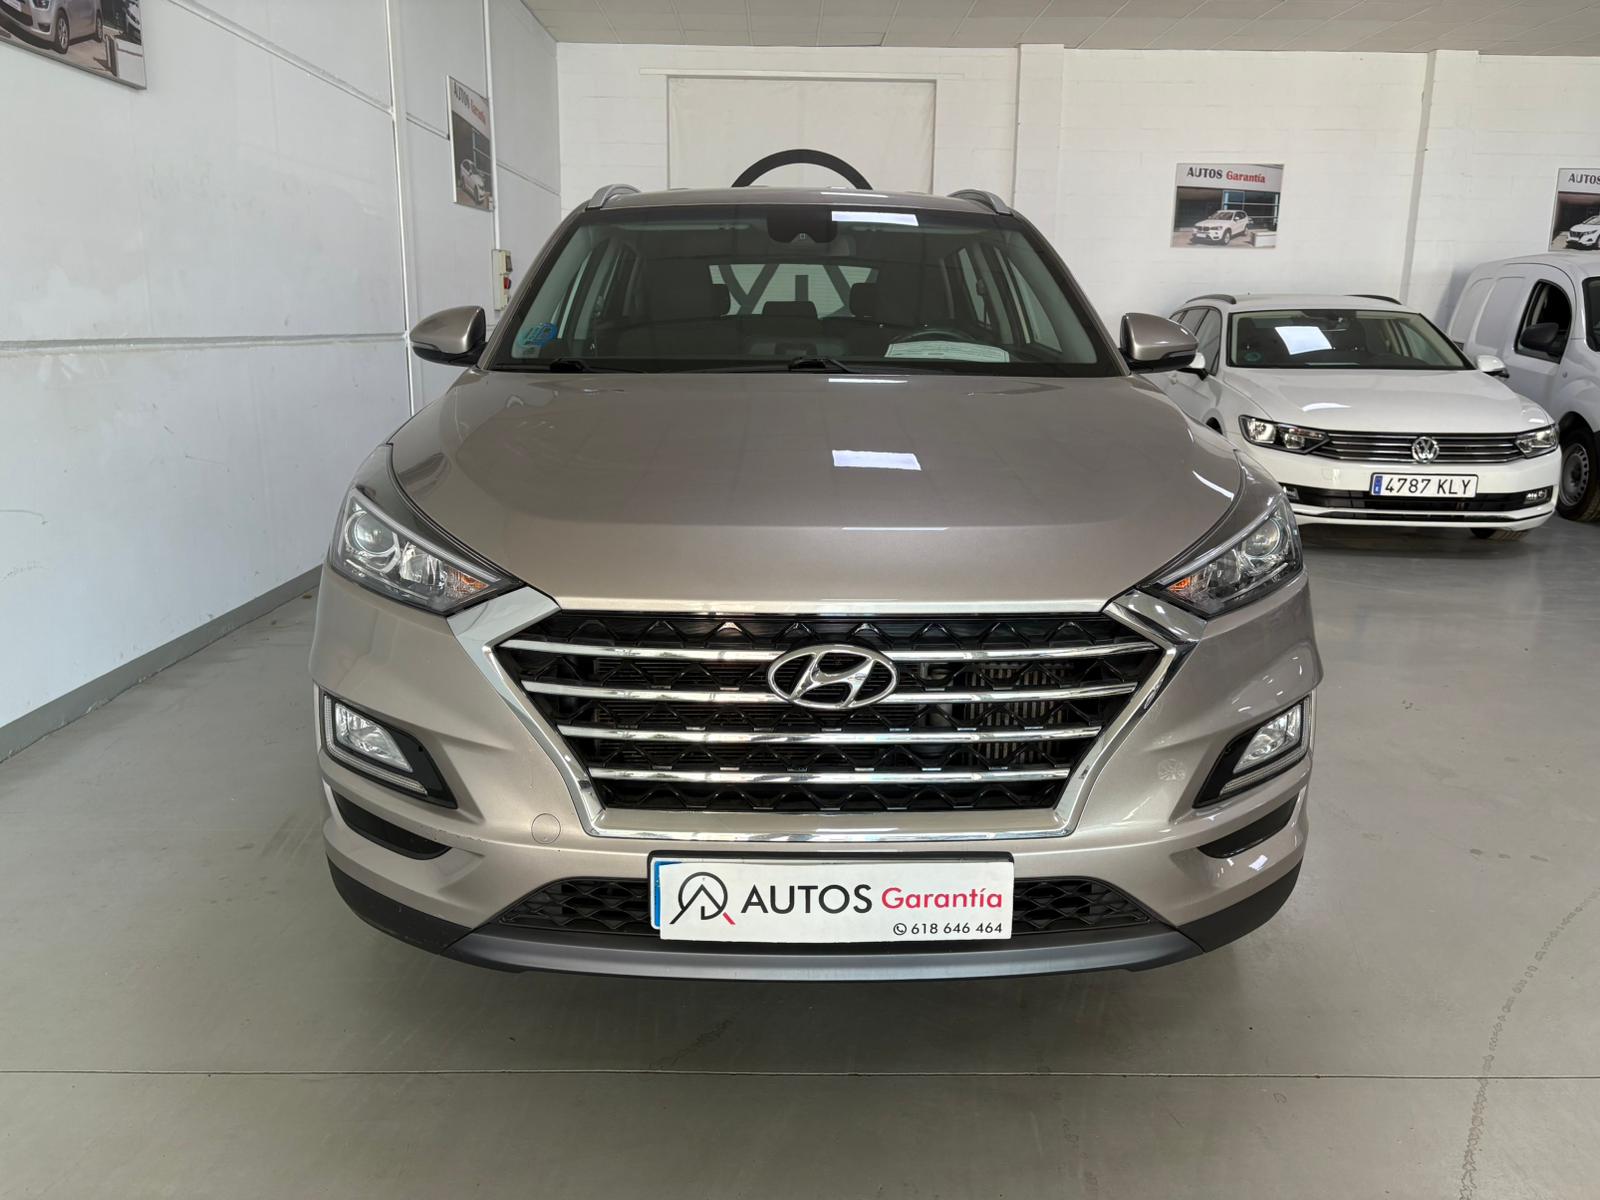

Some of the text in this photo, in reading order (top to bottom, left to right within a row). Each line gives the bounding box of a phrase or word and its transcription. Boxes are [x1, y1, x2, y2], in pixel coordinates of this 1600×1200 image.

[1186, 166, 1266, 183] AUTOS Garantía
[1385, 477, 1431, 494] 4787
[1437, 479, 1471, 495] KLY
[741, 884, 1003, 914] AUTOS Garantía
[911, 922, 1003, 935] 618 646 464
